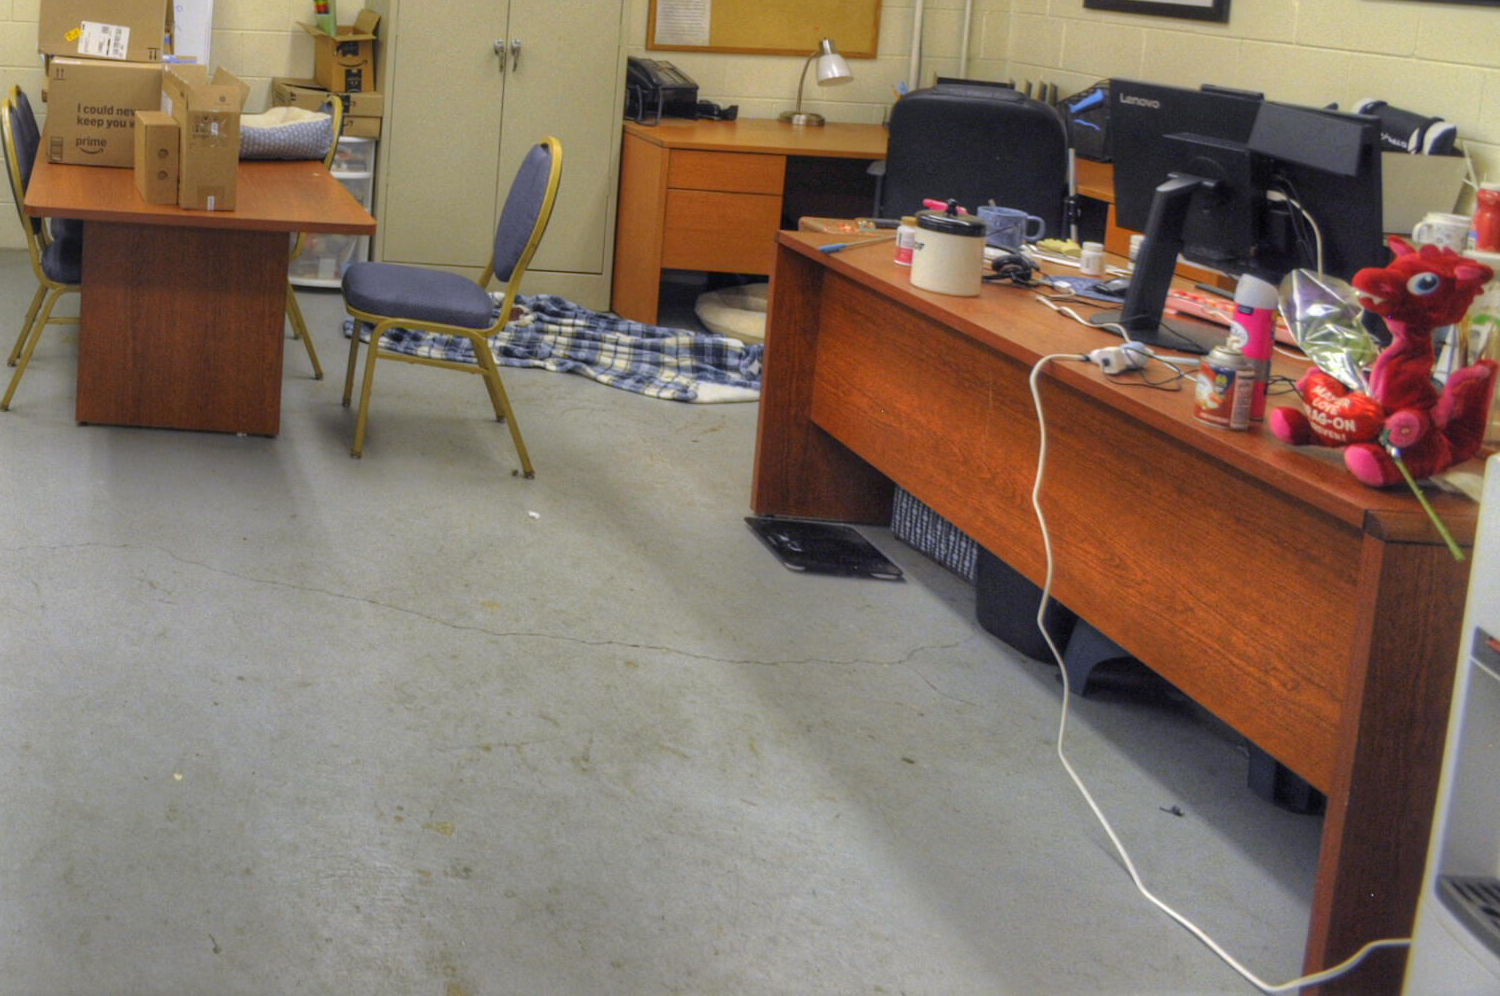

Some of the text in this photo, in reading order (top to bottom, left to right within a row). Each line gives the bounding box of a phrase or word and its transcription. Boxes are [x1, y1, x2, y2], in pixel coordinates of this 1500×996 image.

[1119, 92, 1160, 109] Lenovo
[83, 105, 114, 116] could
[76, 116, 104, 129] keep
[106, 119, 127, 129] you
[75, 135, 107, 148] prime
[1312, 397, 1341, 416] LOVE
[1304, 405, 1357, 433] RAG-ON
